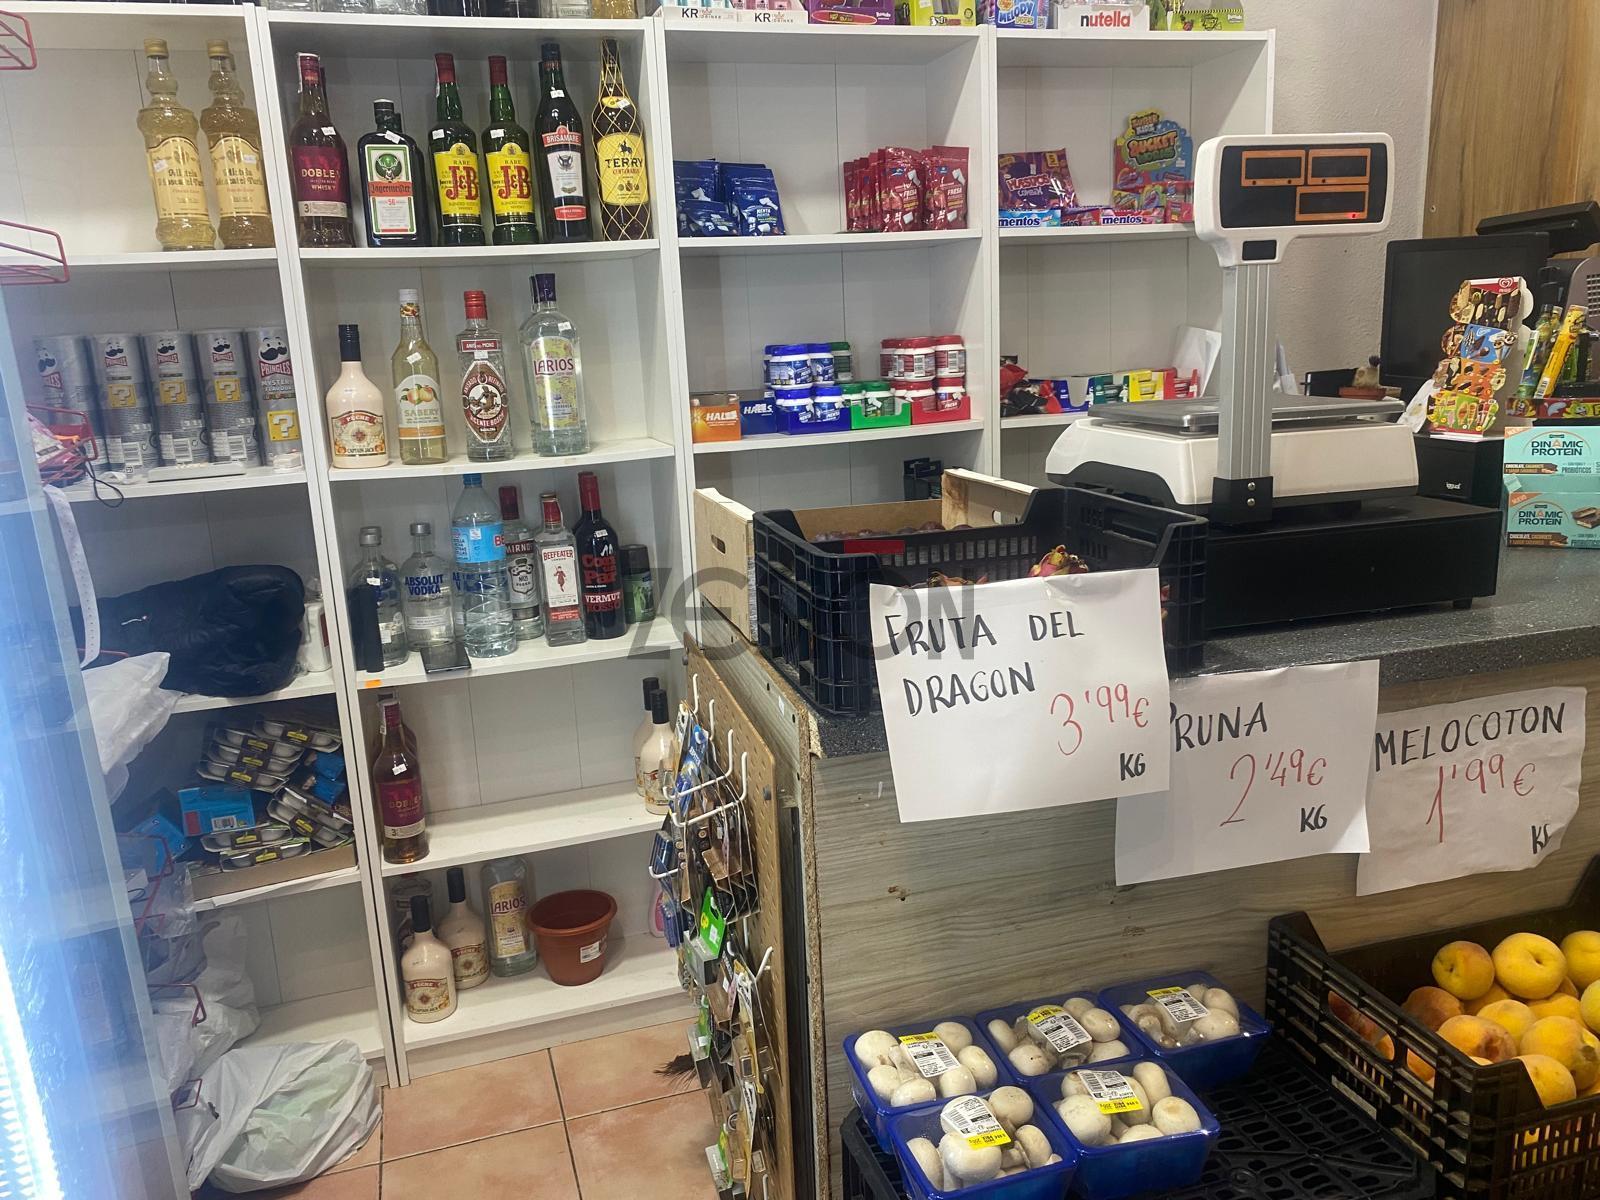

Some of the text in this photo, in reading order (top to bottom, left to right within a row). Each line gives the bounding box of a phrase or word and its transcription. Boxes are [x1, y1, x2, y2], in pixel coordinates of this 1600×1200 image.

[682, 8, 699, 18] KR
[754, 12, 771, 23] KR
[998, 1, 1035, 24] MELODY
[1080, 11, 1131, 27] nutella
[604, 157, 642, 168] TERRY
[301, 168, 335, 178] DOBLE
[445, 165, 479, 200] J&B
[497, 165, 531, 199] J&B
[998, 216, 1040, 226] mentos
[1102, 215, 1142, 224] mentos
[260, 361, 291, 377] PRINGLES
[533, 358, 574, 375] LARIOS
[1531, 440, 1584, 448] DINAMIC
[1531, 448, 1583, 456] PROTEIN
[1518, 510, 1563, 518] DINAMIC
[1518, 518, 1562, 526] PROTEIN
[543, 549, 574, 560] BEEFEATER
[404, 574, 444, 587] ABSOLUT
[408, 585, 441, 596] VODKA
[584, 592, 620, 603] VERMUT
[884, 610, 1085, 656] FRUTA DEL
[902, 661, 1036, 717] DRAGON
[1375, 702, 1566, 773] MELOCOTON
[1119, 752, 1146, 781] KG
[1300, 803, 1328, 833] KG
[490, 895, 528, 915] LARIOS
